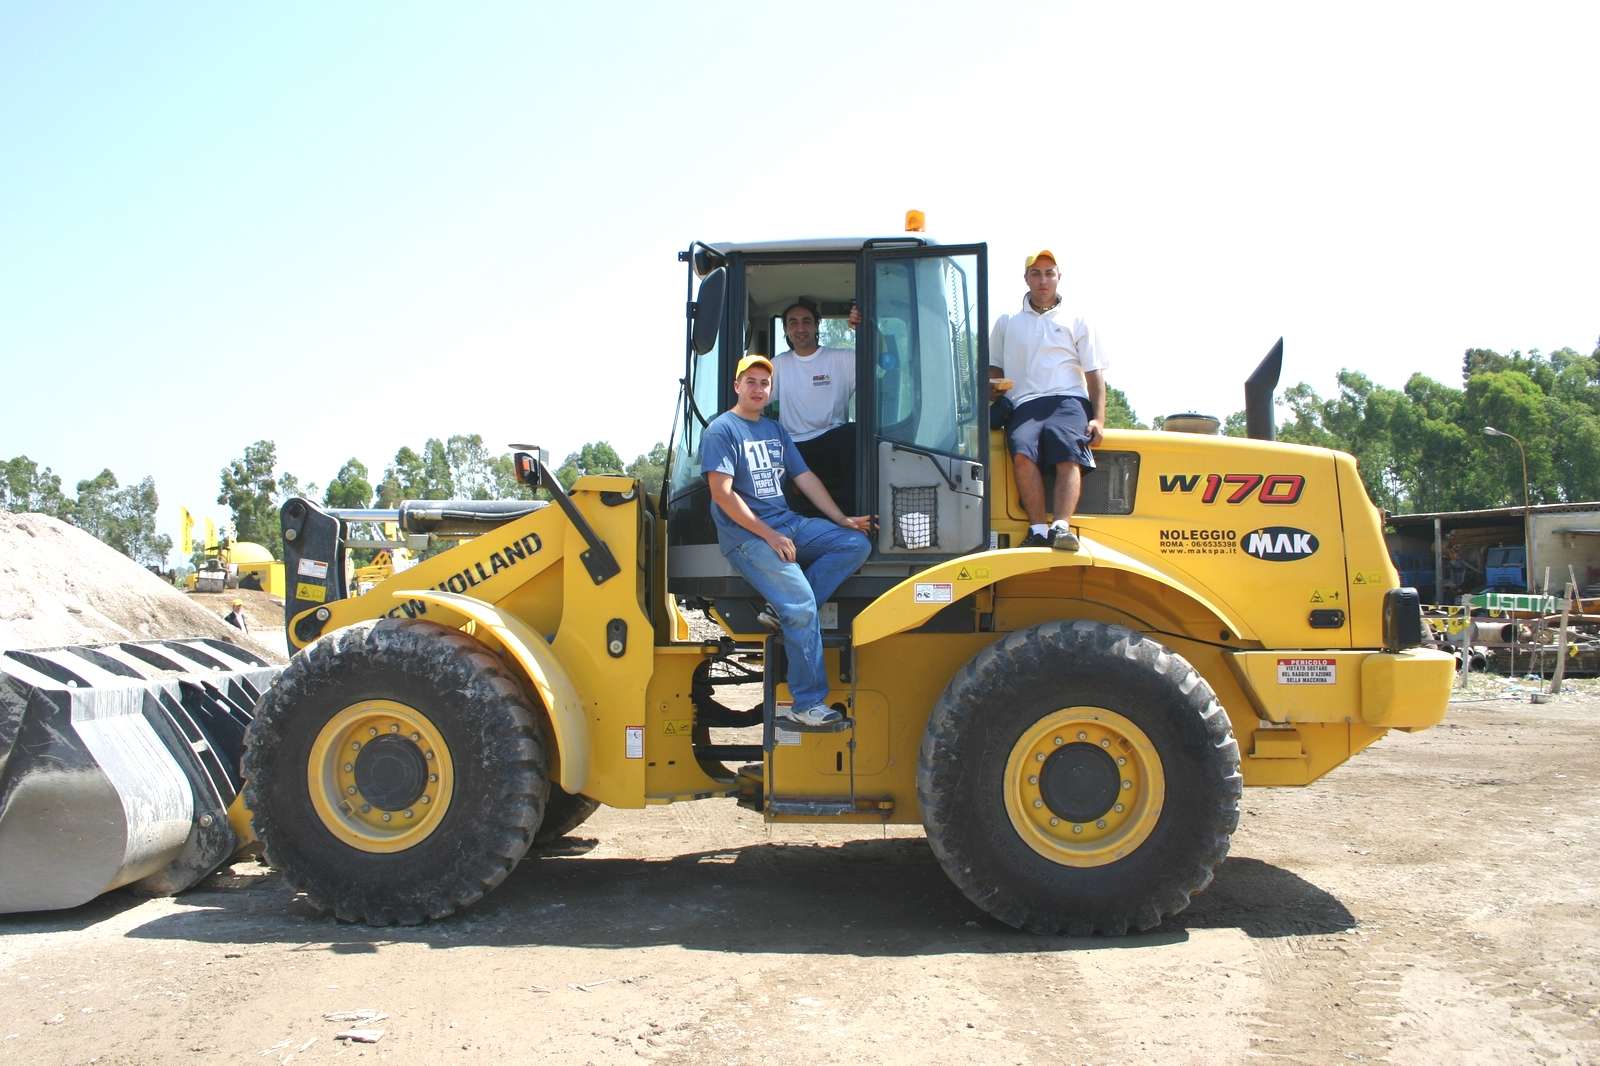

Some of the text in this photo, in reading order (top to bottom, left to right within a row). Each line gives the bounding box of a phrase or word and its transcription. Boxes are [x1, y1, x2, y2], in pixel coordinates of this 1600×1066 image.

[1159, 473, 1306, 504] W170
[1159, 530, 1237, 540] NOLEGGIO
[1248, 530, 1313, 558] MAK
[379, 598, 427, 619] EW
[1486, 592, 1556, 613] USCITA
